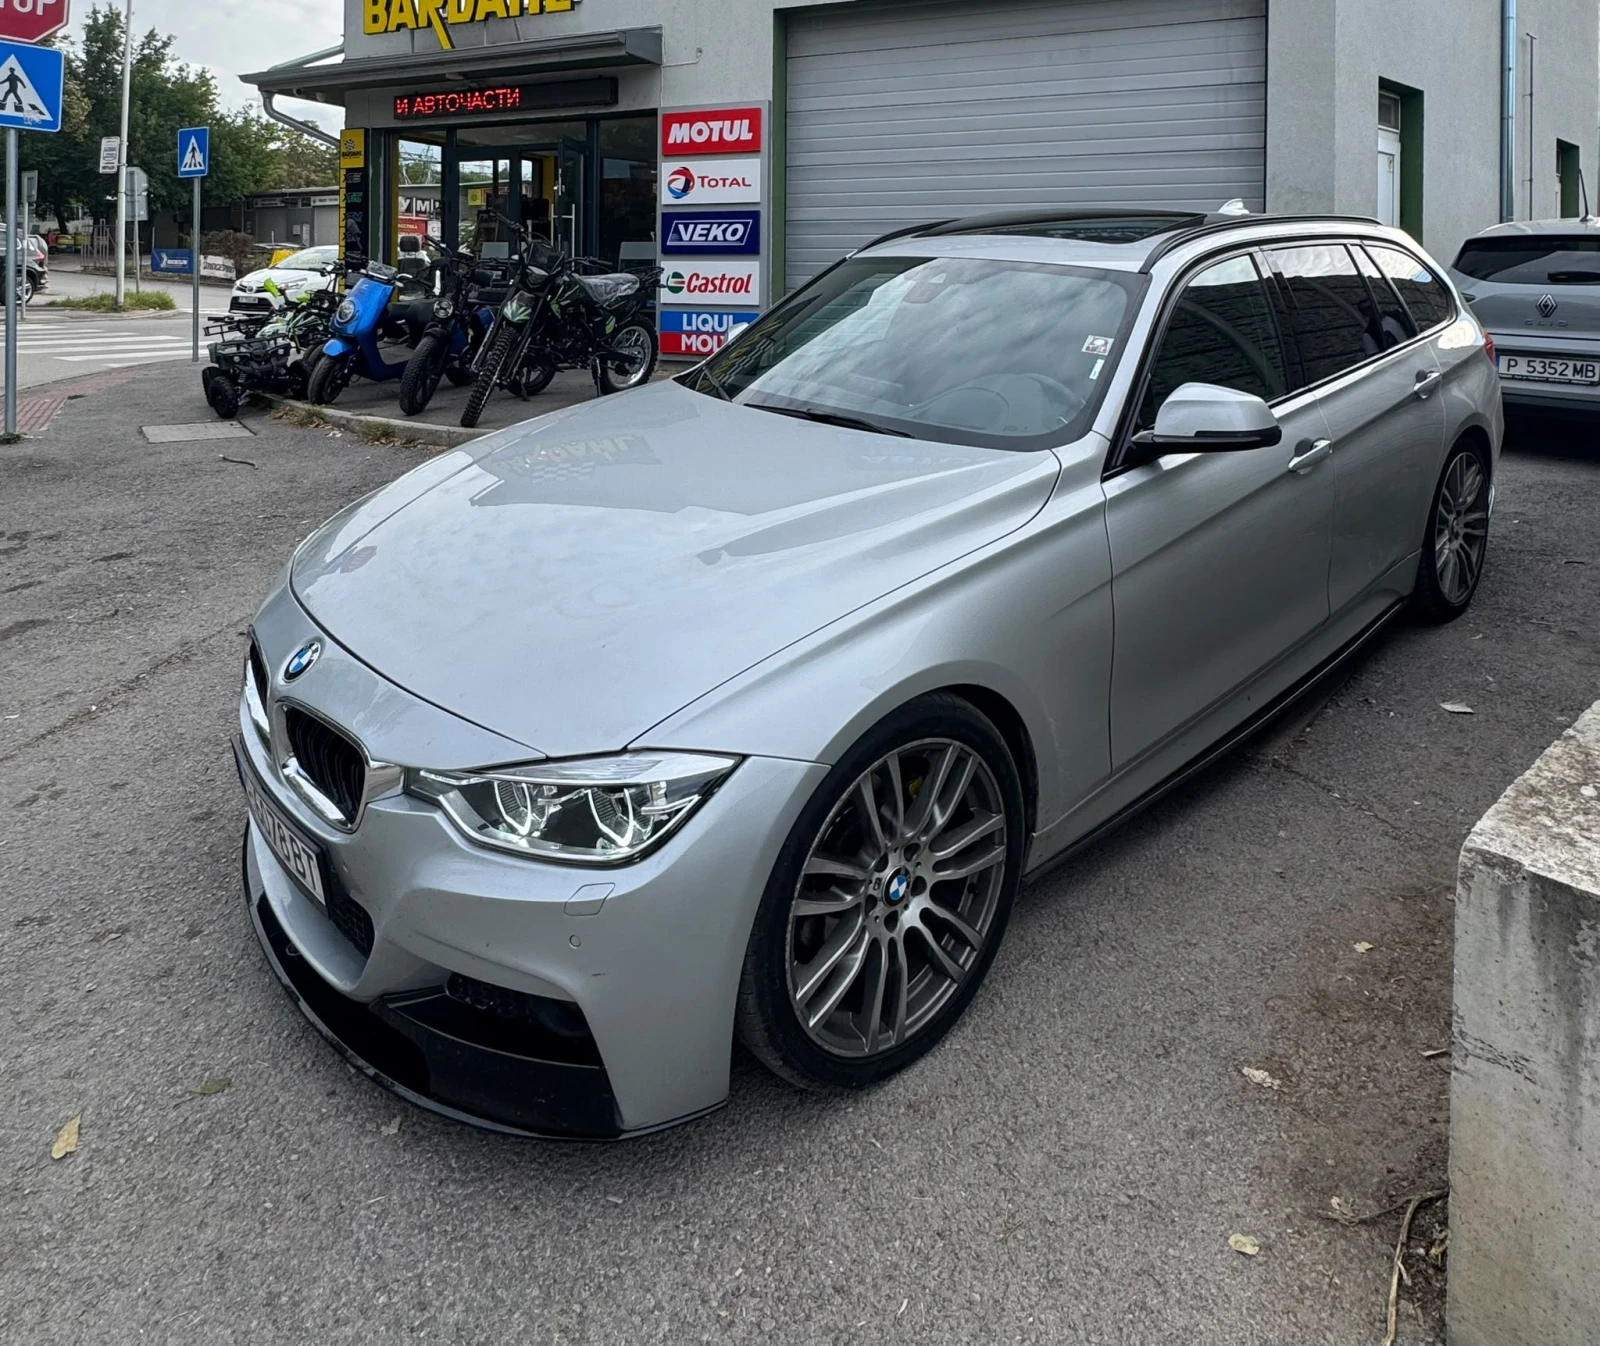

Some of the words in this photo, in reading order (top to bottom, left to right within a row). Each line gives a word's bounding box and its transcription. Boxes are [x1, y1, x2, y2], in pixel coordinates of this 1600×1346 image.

[364, 0, 573, 49] BARDA
[396, 98, 408, 115] И
[413, 87, 520, 115] АВТОЧАСТИ
[667, 119, 753, 144] MOTUL
[677, 223, 744, 241] VEKO
[686, 272, 752, 293] Castrol
[681, 334, 725, 352] MOL
[1507, 358, 1518, 372] P
[1526, 360, 1569, 377] 5352
[1572, 363, 1596, 379] MB
